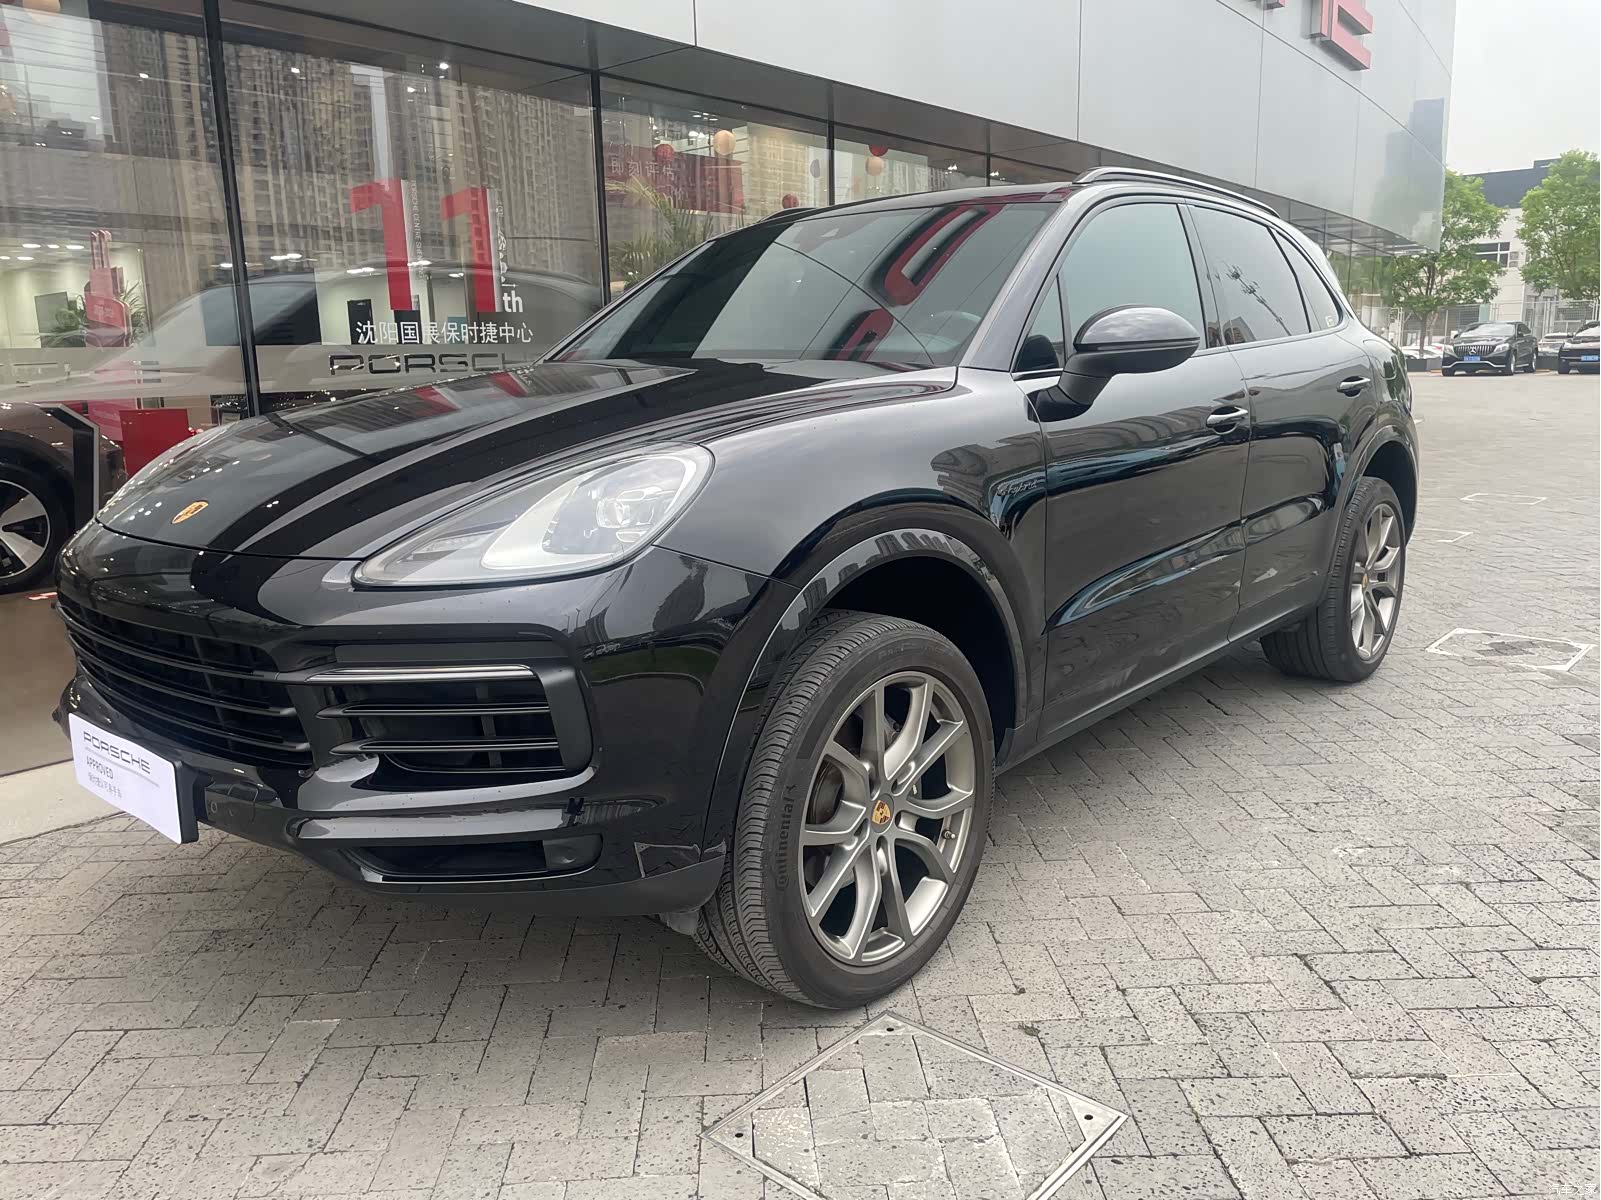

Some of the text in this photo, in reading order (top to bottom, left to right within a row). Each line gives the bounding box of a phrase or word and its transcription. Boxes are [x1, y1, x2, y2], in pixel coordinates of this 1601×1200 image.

[356, 321, 534, 345] 沈阳国展保时捷中心
[83, 732, 150, 774] PORSCHE
[87, 756, 113, 779] APPROVED
